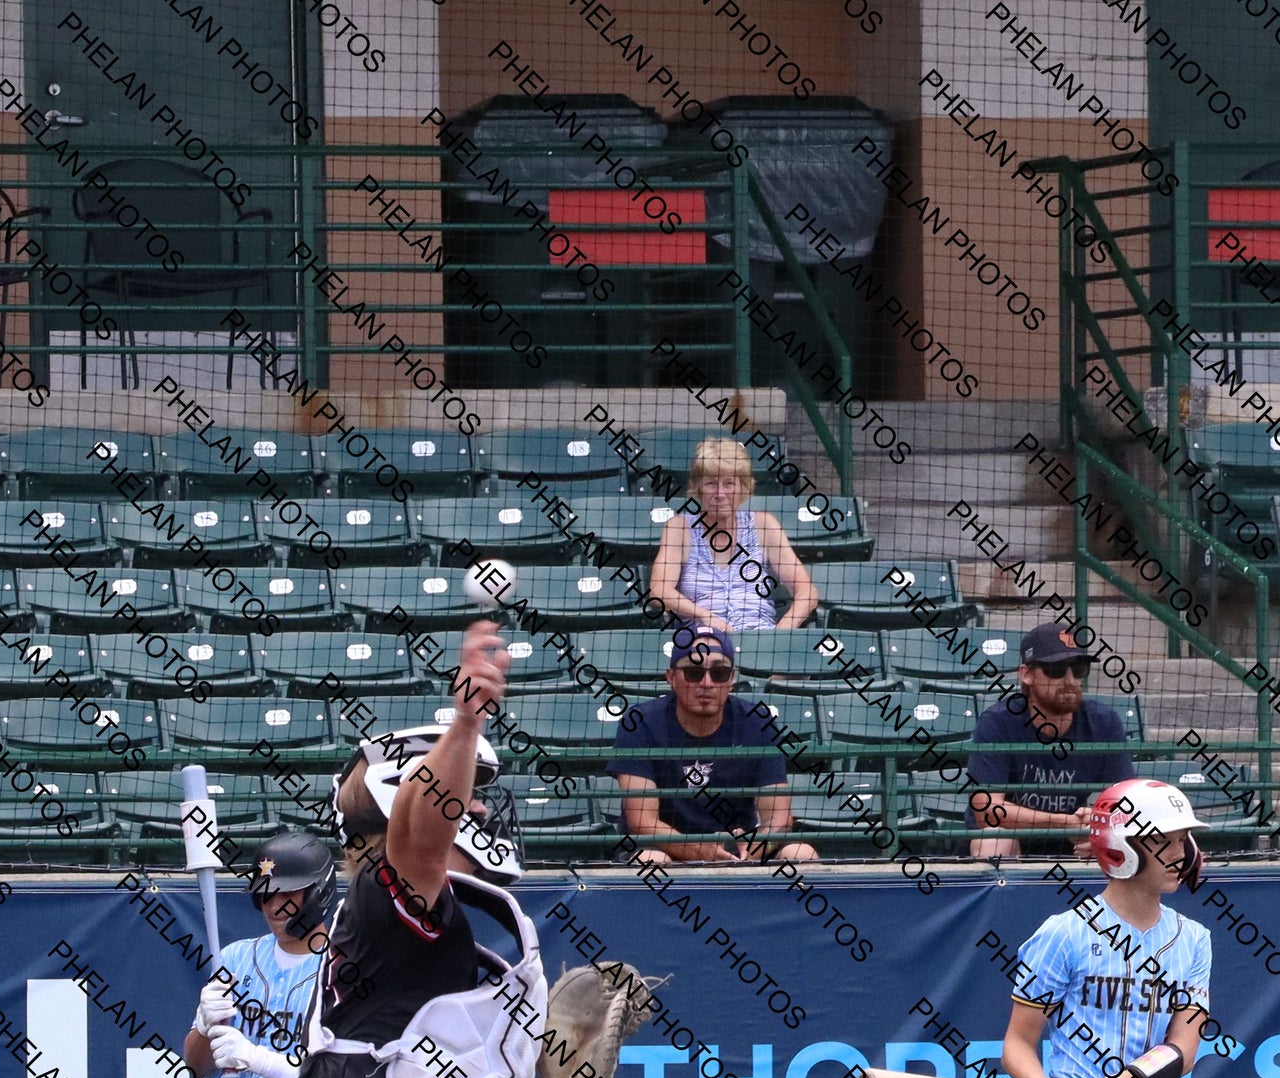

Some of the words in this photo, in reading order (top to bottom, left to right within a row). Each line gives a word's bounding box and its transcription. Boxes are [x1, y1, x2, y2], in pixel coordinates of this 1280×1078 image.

[1012, 792, 1078, 813] MOTHER
[1080, 975, 1136, 1012] FIVE
[1138, 978, 1188, 1014] STA
